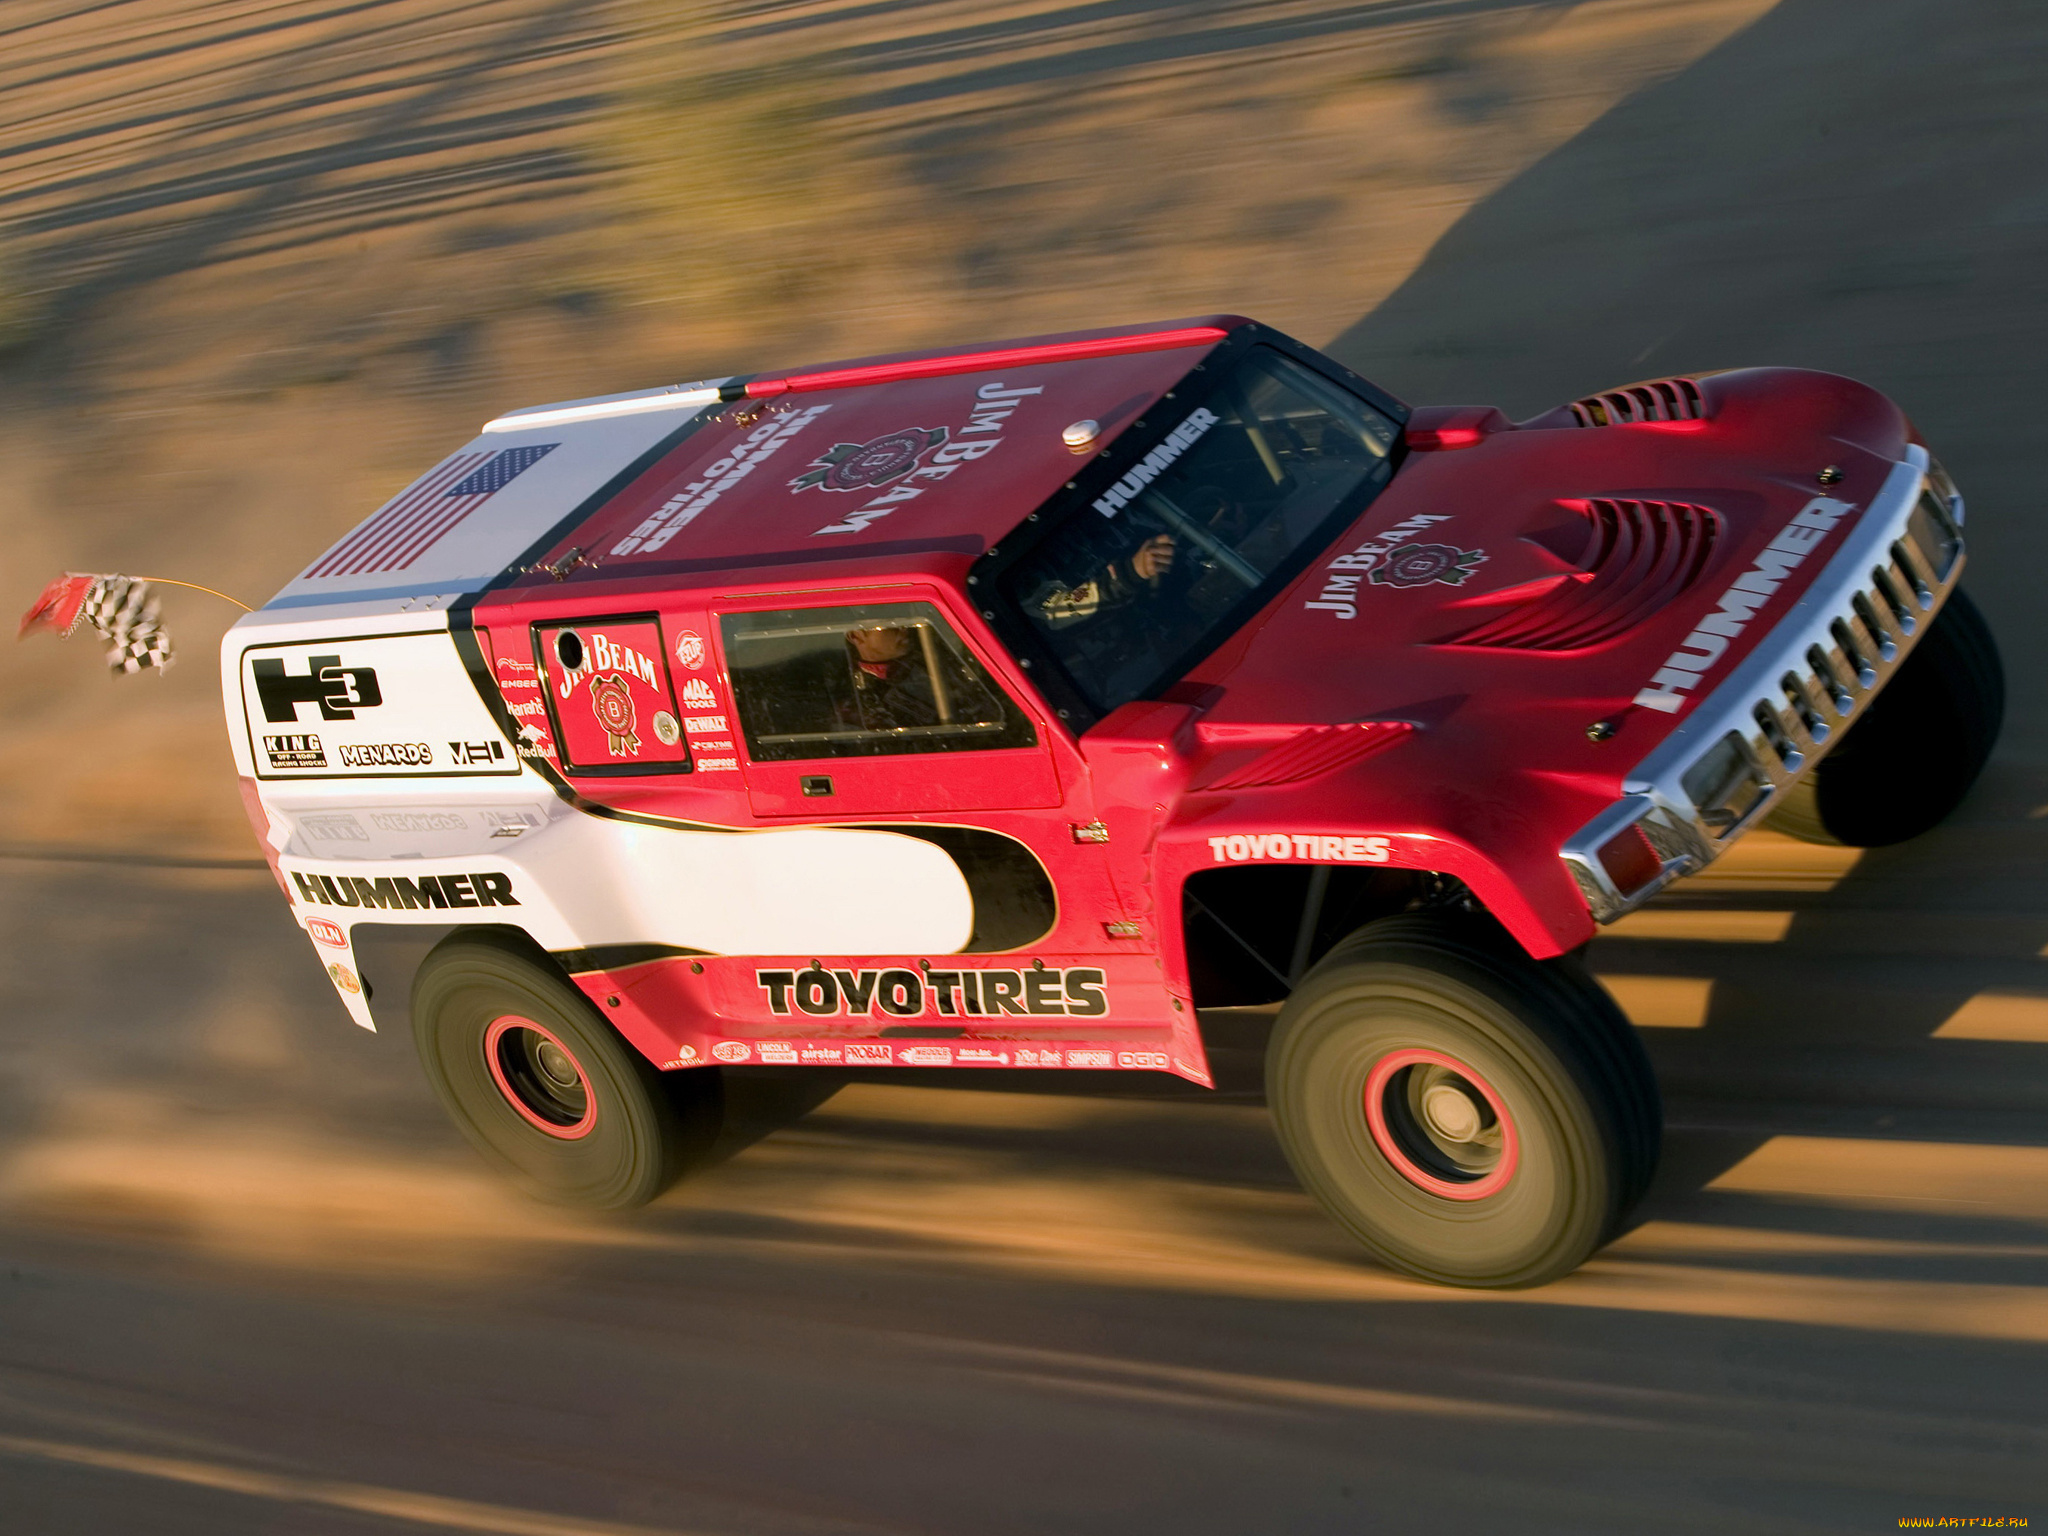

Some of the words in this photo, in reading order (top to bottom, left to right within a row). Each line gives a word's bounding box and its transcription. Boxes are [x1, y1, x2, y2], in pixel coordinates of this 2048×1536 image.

[956, 382, 1044, 436] JIM
[633, 403, 834, 556] HUMMER
[1091, 407, 1221, 519] HUMMER
[807, 435, 1006, 537] BEAM
[1325, 514, 1456, 570] BEAM
[1304, 573, 1362, 620] JIM
[1631, 497, 1858, 714] HUMMER
[591, 634, 661, 695] BEAM
[251, 655, 383, 723] H3
[501, 680, 538, 689] EMBEE
[683, 678, 716, 700] MAC
[608, 701, 620, 718] B
[684, 700, 717, 709] TOOLS
[265, 735, 321, 752] KING
[339, 743, 433, 767] MENARDS
[290, 871, 523, 910] HUMMER
[801, 1044, 842, 1058] airstar
[1068, 1052, 1110, 1065] SIMPSON
[1117, 1051, 1170, 1068] OGIO
